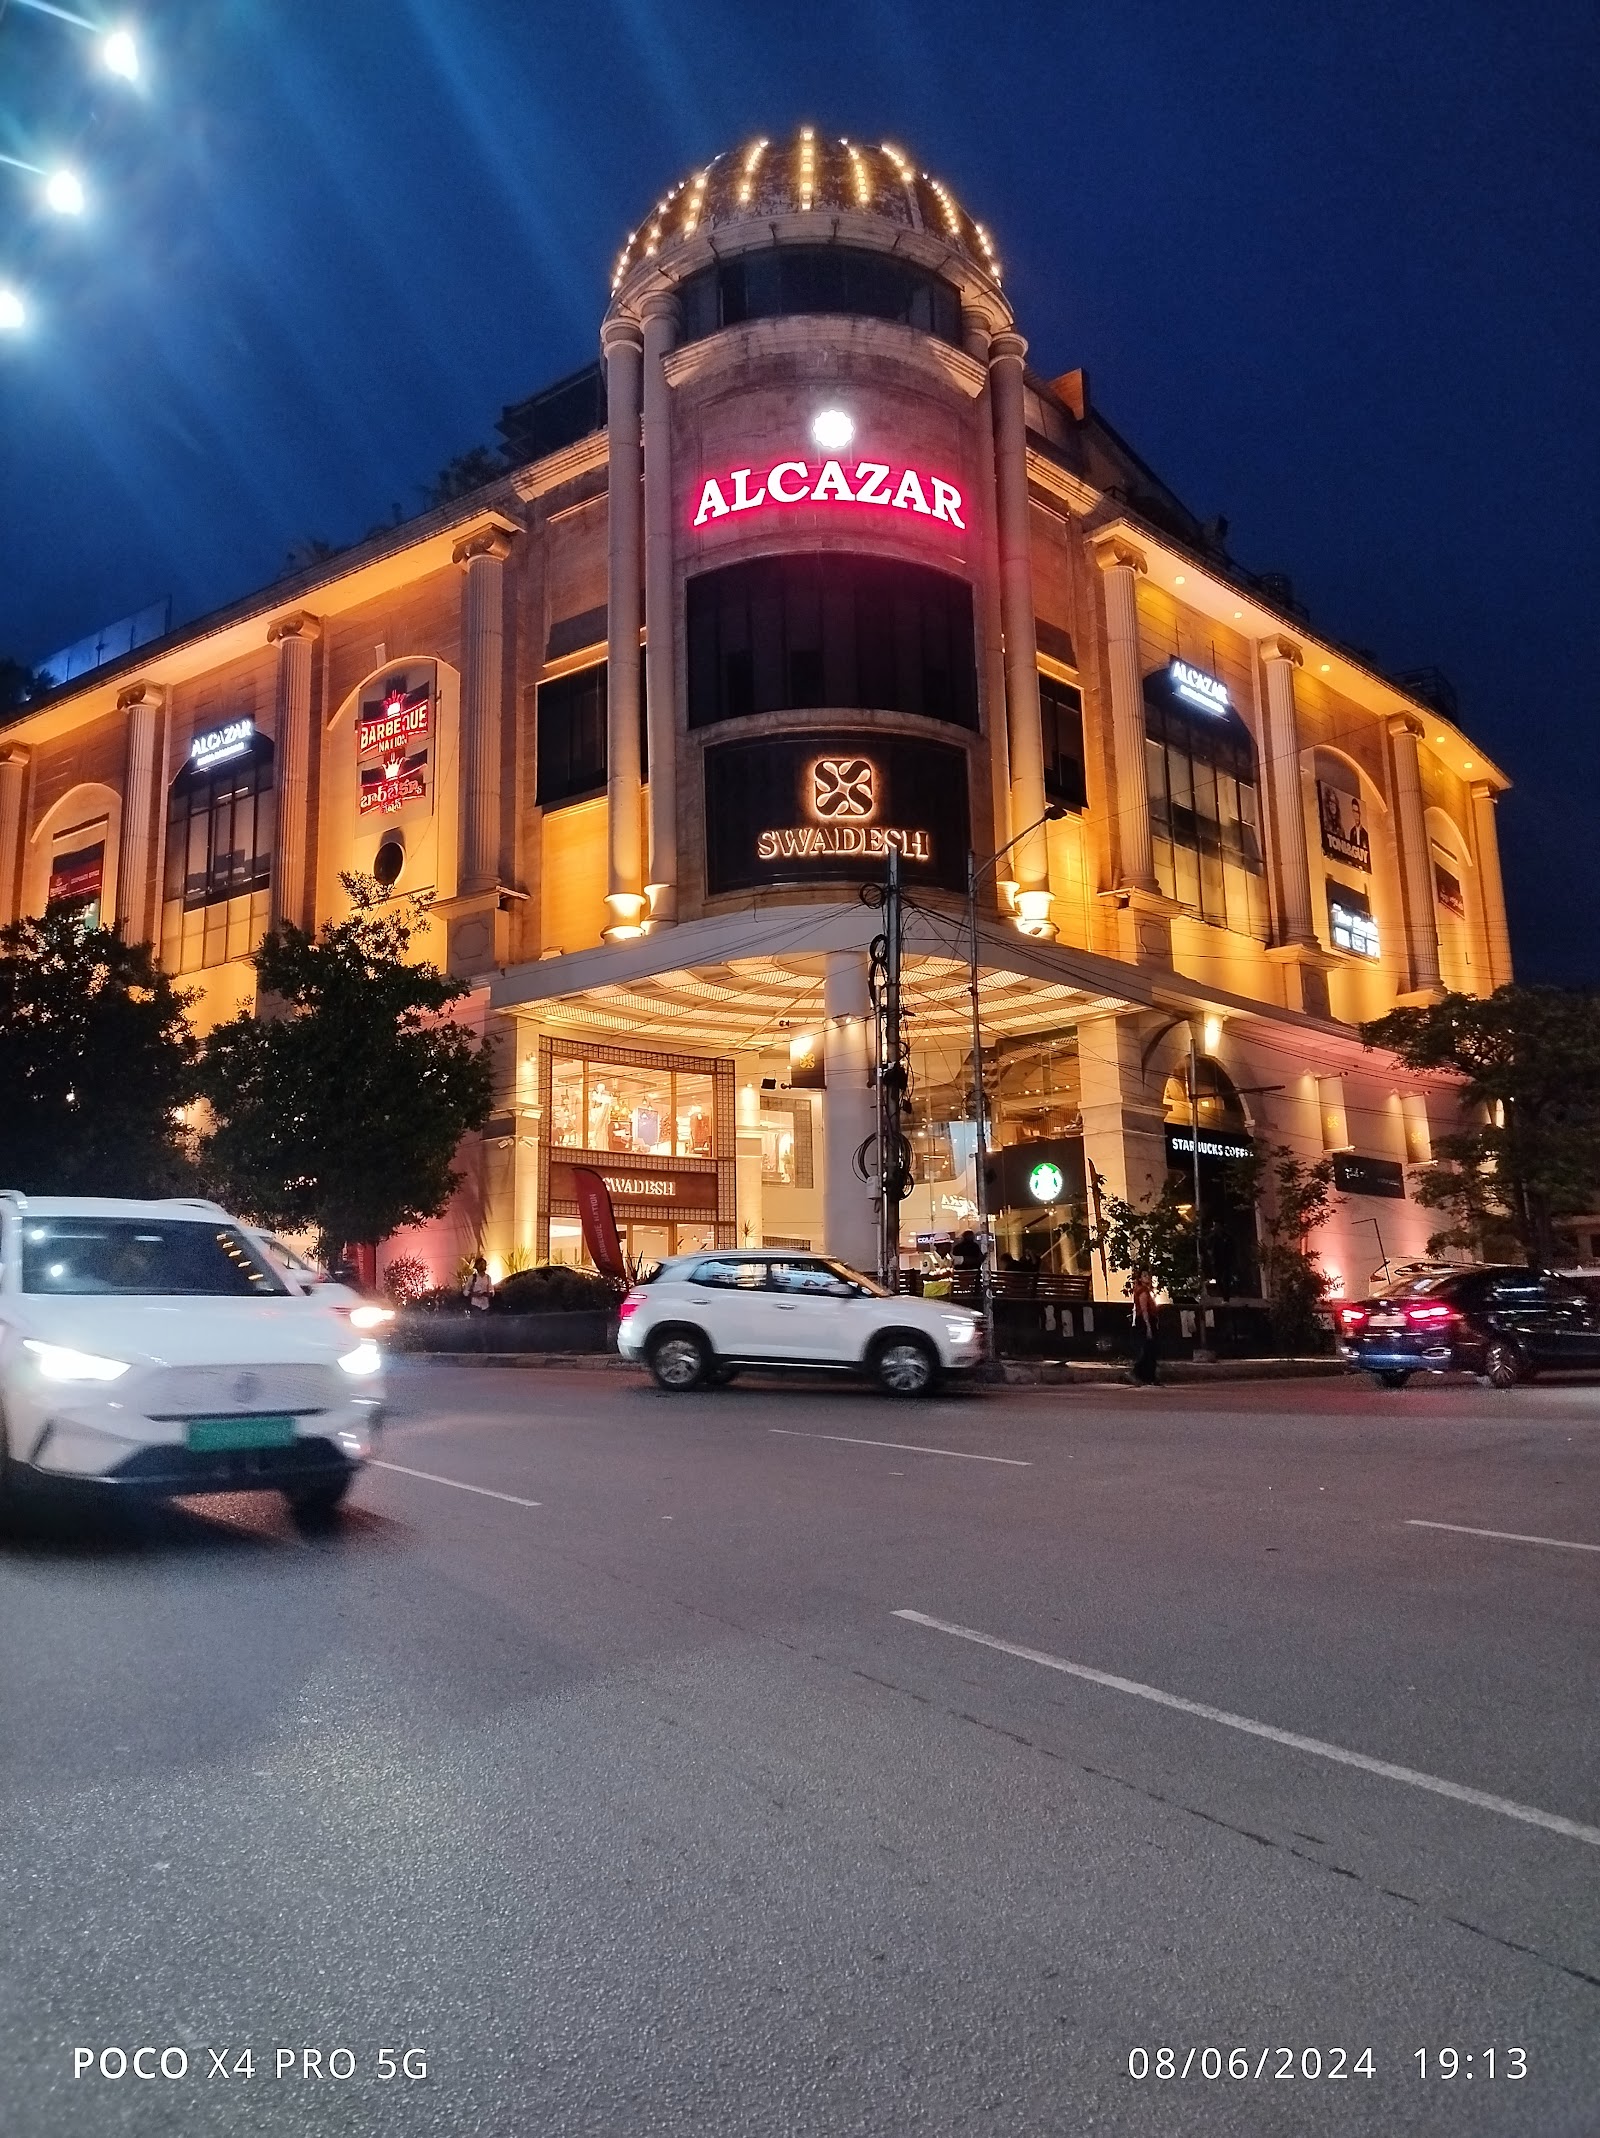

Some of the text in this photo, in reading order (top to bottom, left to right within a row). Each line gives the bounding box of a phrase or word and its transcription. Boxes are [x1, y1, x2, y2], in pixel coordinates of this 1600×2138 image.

[693, 460, 966, 530] ALCAZAR
[1173, 661, 1229, 705] ALCAZAR
[191, 720, 252, 758] ALCAZAR
[360, 704, 428, 750] BARBEQUE
[378, 735, 408, 753] NATION
[758, 827, 930, 859] SWADESH
[1326, 832, 1368, 864] TONI&GUY
[602, 1177, 676, 1196] SWADESH
